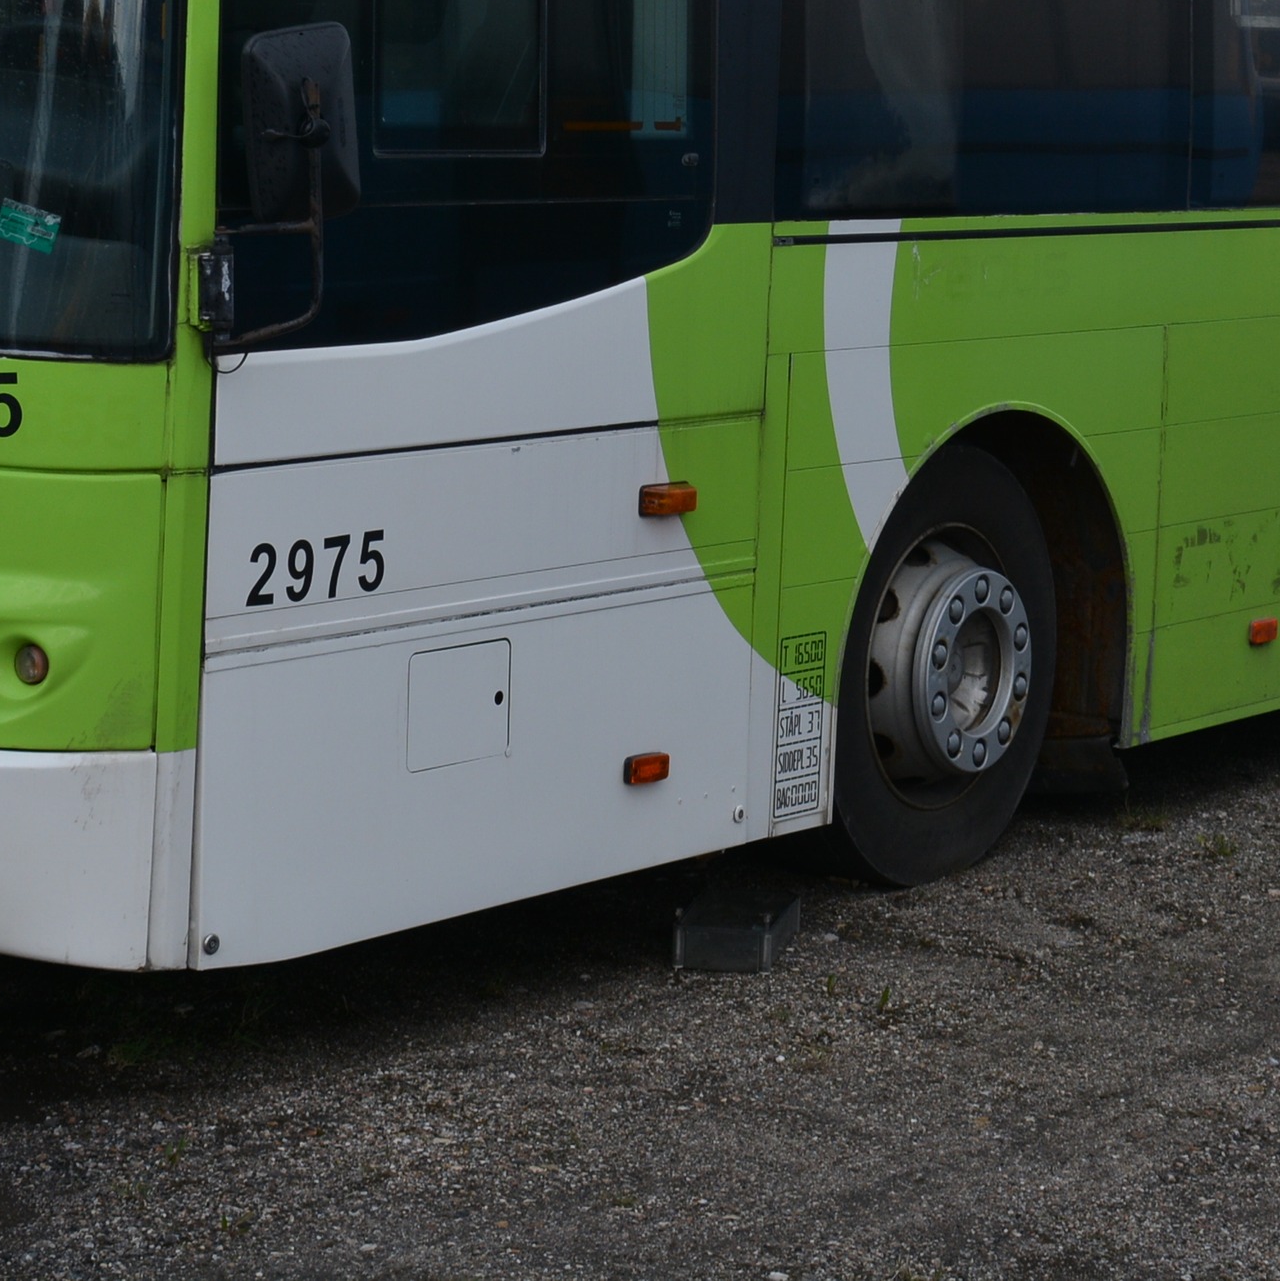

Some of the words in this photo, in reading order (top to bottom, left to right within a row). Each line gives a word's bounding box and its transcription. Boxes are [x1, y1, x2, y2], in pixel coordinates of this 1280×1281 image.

[245, 529, 386, 607] 2975
[783, 645, 789, 668] T
[794, 639, 824, 666] 16500
[781, 681, 787, 703] L
[795, 674, 823, 701] 5650
[779, 710, 802, 739] STÅPL
[778, 749, 805, 775] SIDDEPL
[776, 784, 791, 811] BAG
[791, 780, 817, 806] 0000
